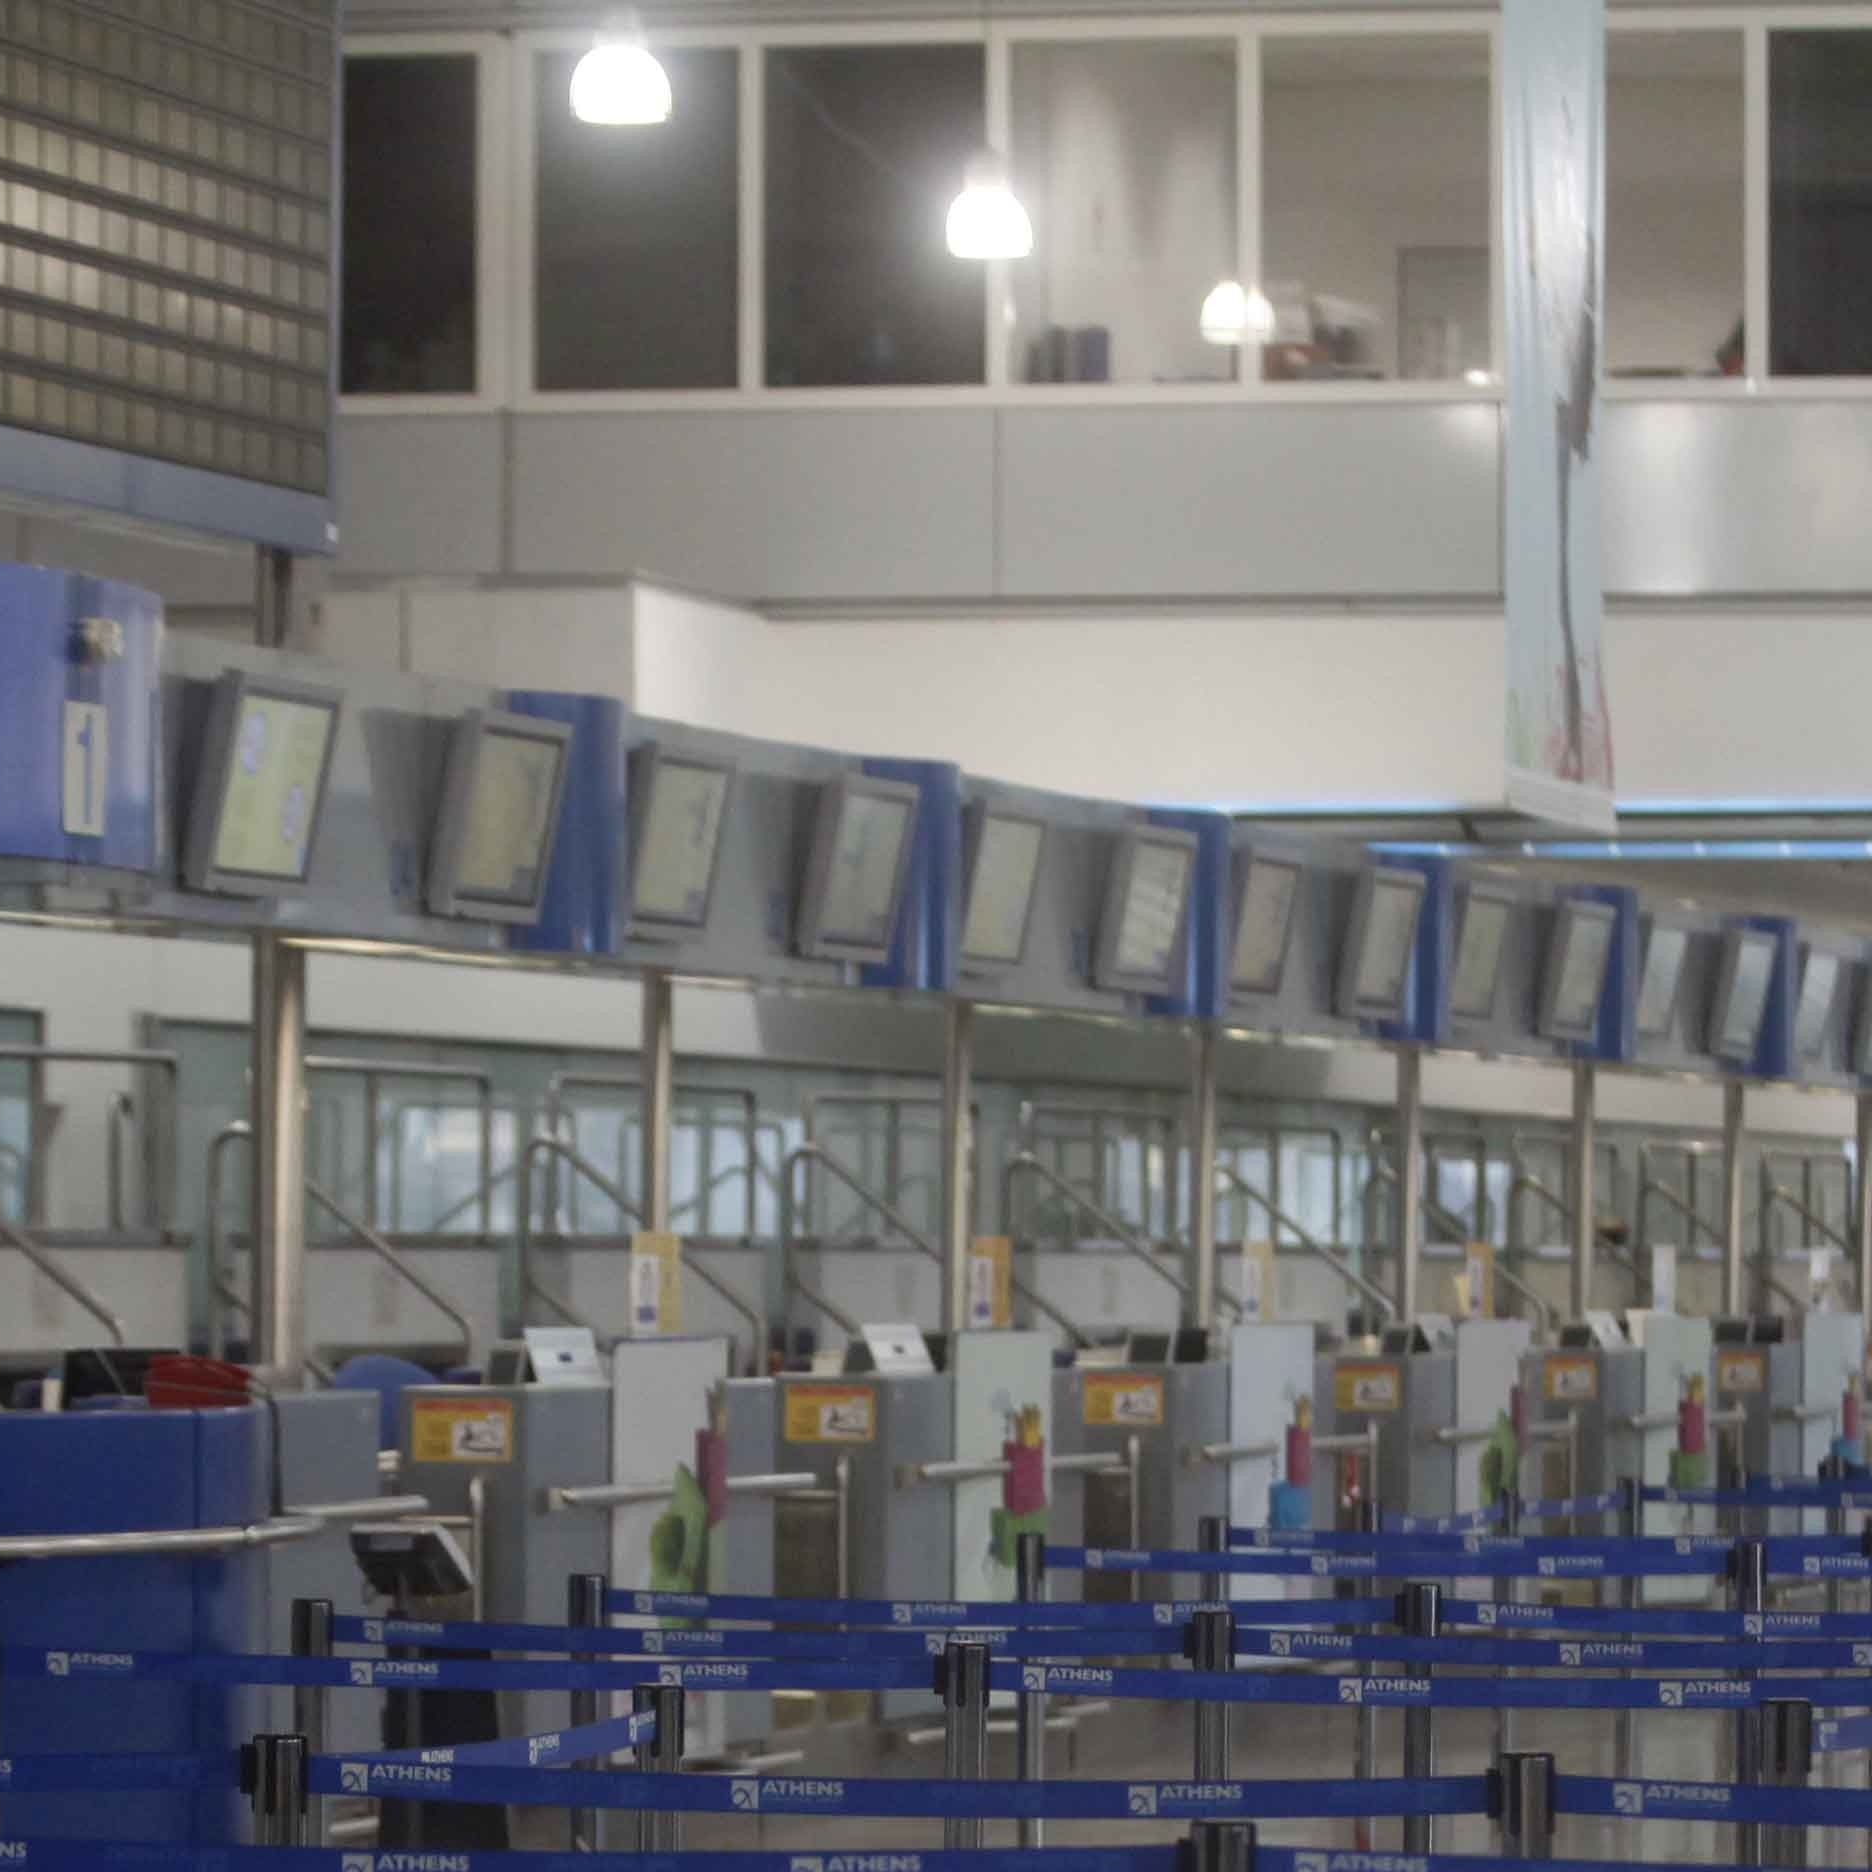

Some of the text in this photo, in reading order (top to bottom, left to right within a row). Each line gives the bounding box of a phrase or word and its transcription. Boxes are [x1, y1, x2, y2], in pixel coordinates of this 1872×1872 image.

[1498, 1606, 1553, 1617] ATHENS
[1765, 1616, 1820, 1627] ATHENS
[1292, 1635, 1352, 1647] ATHENS
[1583, 1644, 1644, 1656] ATHENS
[71, 1653, 133, 1666] ATHENS
[374, 1662, 439, 1676] ATHENS
[683, 1665, 748, 1677] ATHENS
[1048, 1668, 1113, 1681] ATHENS
[1365, 1679, 1431, 1691] ATHENS
[1685, 1682, 1751, 1695] ATHENS
[371, 1764, 453, 1782] ATHENS
[762, 1781, 844, 1797] ATHENS
[1160, 1785, 1242, 1800] ATHENS
[1646, 1787, 1731, 1802] ATHENS
[378, 1853, 470, 1872] ATHENS
[828, 1857, 920, 1872] ATHENS
[1332, 1857, 1427, 1872] ATHENS
